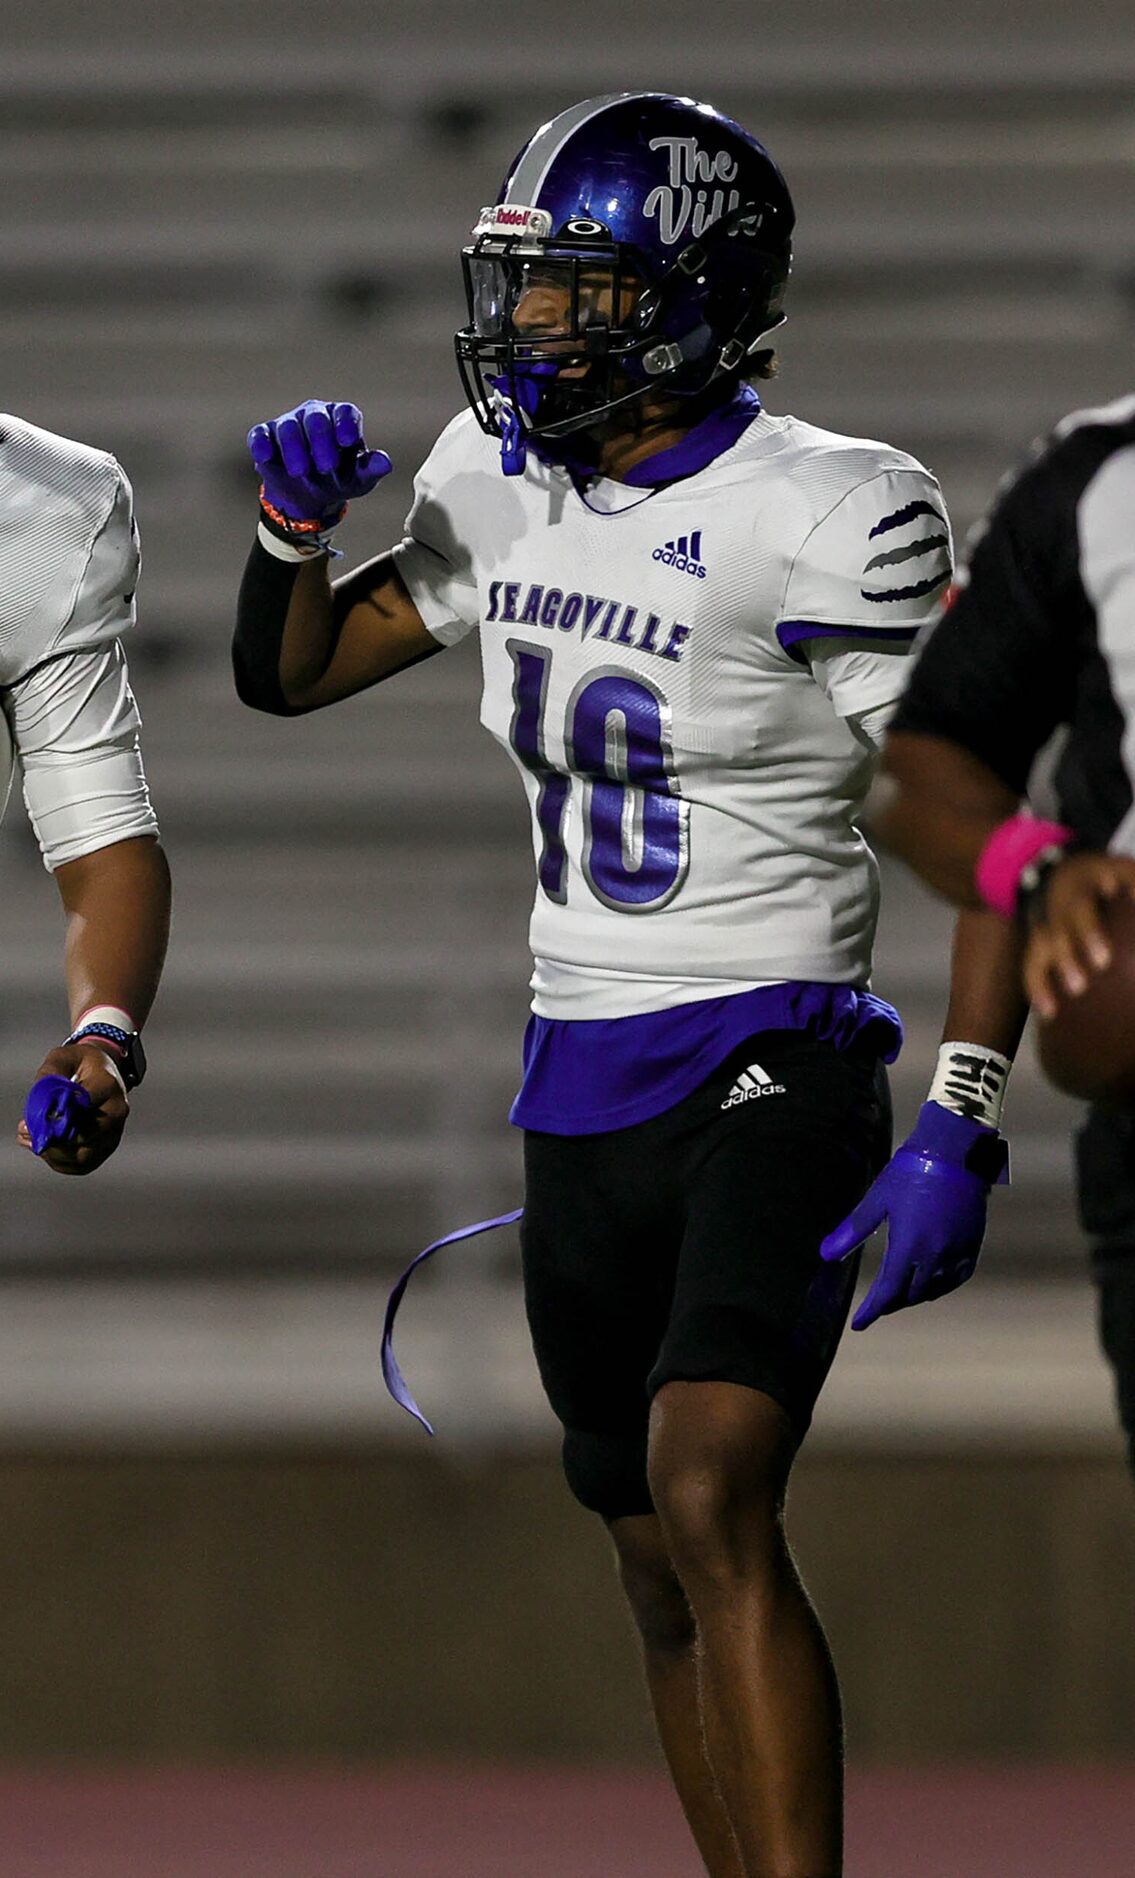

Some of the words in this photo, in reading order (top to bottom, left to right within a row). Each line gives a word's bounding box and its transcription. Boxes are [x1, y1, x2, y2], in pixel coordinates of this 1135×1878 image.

[648, 136, 739, 189] The
[652, 548, 707, 579] adidas
[485, 580, 693, 663] SEAGOVILLE
[720, 1085, 787, 1110] adidas
